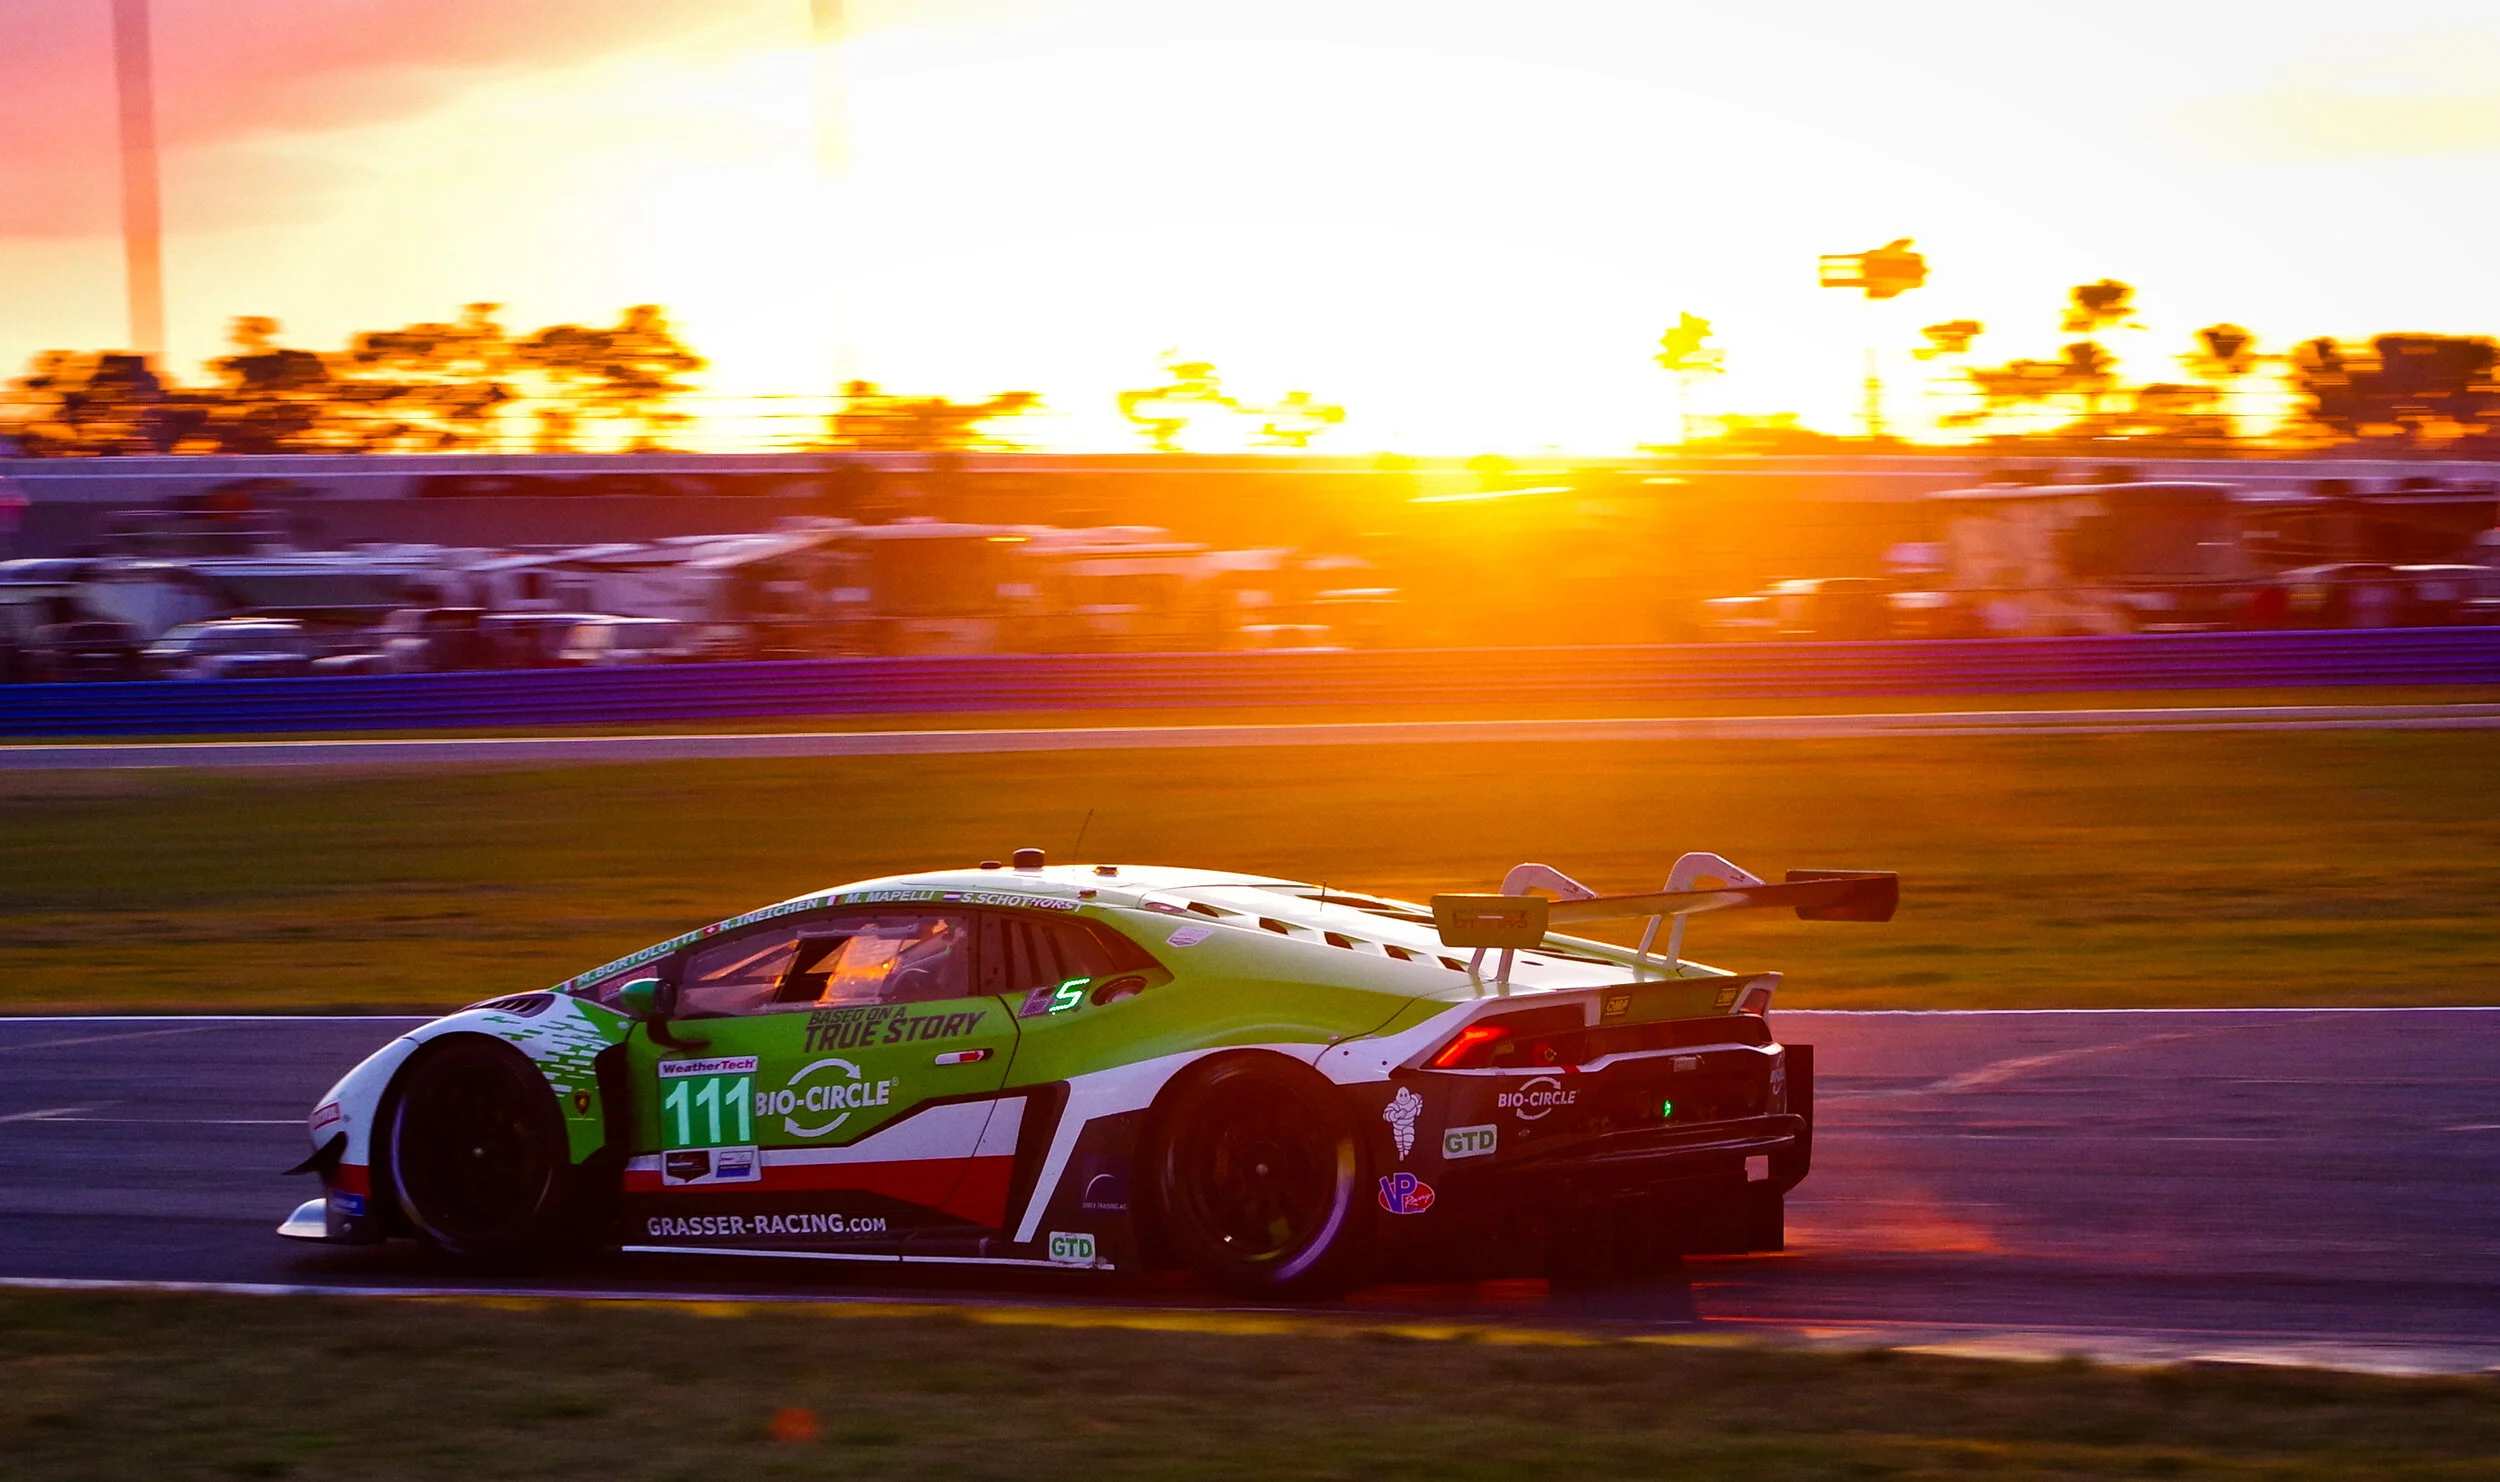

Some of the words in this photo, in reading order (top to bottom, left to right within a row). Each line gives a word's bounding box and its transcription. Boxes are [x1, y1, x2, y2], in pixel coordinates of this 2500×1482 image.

[866, 890, 935, 903] MAPELLI
[1048, 976, 1091, 1014] 5
[808, 1009, 866, 1025] BASED
[866, 1007, 893, 1021] ON
[896, 1006, 908, 1018] A
[804, 1020, 882, 1053] TRUE
[883, 1011, 987, 1044] STORY
[663, 1058, 755, 1074] WeatherTech
[1498, 1090, 1577, 1108] BIO-CIRCLE
[665, 1077, 750, 1145] 111
[1445, 1130, 1495, 1153] GTD
[1379, 1172, 1418, 1214] VP
[1052, 1237, 1093, 1258] GTD
